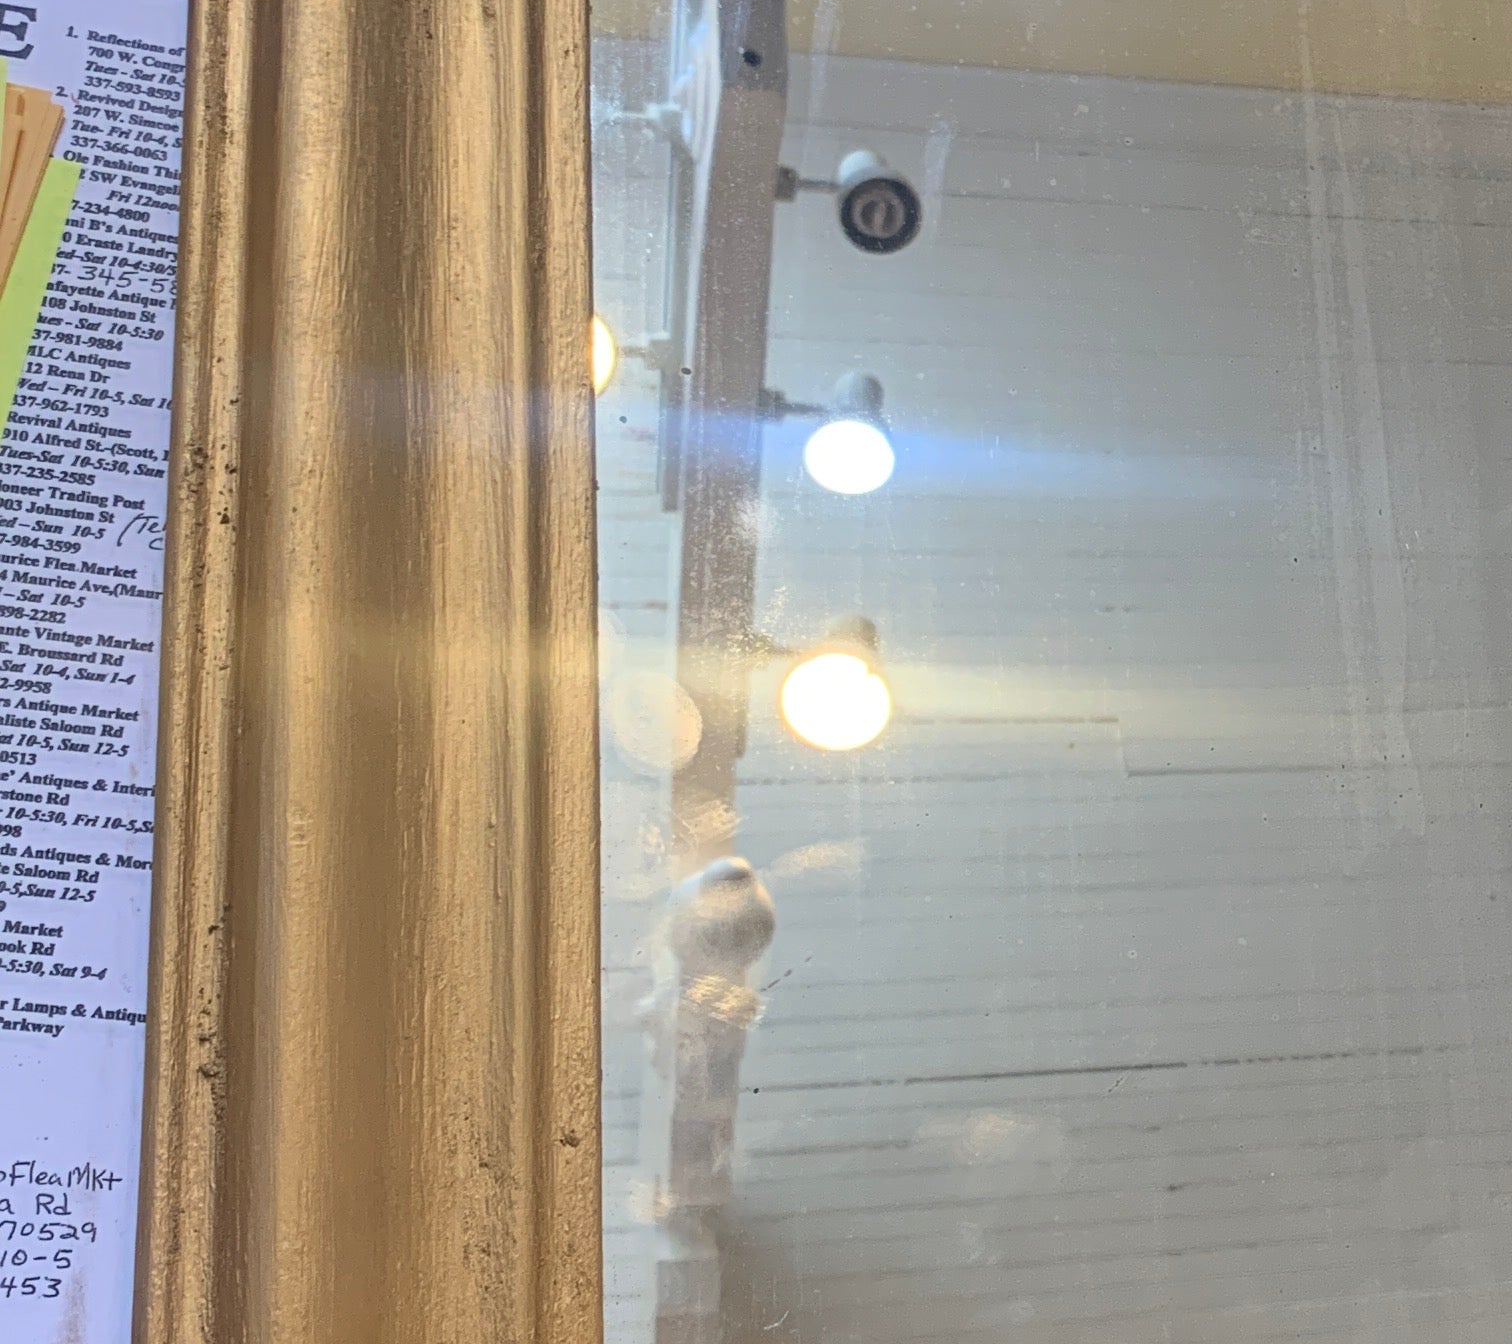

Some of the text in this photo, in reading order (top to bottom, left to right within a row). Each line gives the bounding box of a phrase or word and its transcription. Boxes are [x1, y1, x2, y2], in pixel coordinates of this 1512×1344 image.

[87, 30, 165, 54] Reflections
[169, 47, 186, 56] of
[88, 46, 113, 59] 700
[85, 61, 118, 75] Tues
[130, 69, 156, 82] Sat
[77, 90, 135, 109] Revived
[107, 126, 132, 139] Fri
[128, 115, 180, 132] Simcoe
[63, 150, 89, 164] Ole
[93, 155, 149, 174] Fashion
[89, 170, 117, 185] SW
[106, 190, 132, 203] Fri
[75, 233, 124, 252] Eraste
[107, 289, 167, 308] Antique
[69, 300, 136, 320] Johnston
[139, 311, 156, 323] St
[75, 318, 164, 341] Sat 10-5:30
[64, 351, 131, 370] Antiques
[90, 371, 111, 384] Dr
[62, 384, 87, 398] Fri
[128, 394, 155, 408] Sat
[7, 411, 132, 438] Revival Antiques
[31, 433, 82, 449] Alfred
[133, 464, 166, 478] Sun
[48, 486, 145, 510] Trading Post
[25, 502, 116, 523] Johnston St
[31, 520, 107, 539] Sun 10-5
[43, 557, 76, 571] Flea
[80, 561, 138, 579] Market
[11, 570, 77, 589] Maurice
[16, 589, 44, 603] Sat
[51, 593, 86, 608] 10-5
[34, 627, 93, 647] Vintage
[95, 634, 154, 652] Market
[18, 643, 97, 664] Broussard
[100, 654, 124, 667] Rd
[74, 668, 107, 683] Sun
[14, 697, 78, 716] Antique
[81, 704, 140, 722] Market
[40, 717, 96, 735] Saloom
[100, 724, 124, 738] Rd
[57, 738, 91, 753] Sun
[94, 742, 130, 757] 12-5
[18, 772, 89, 791] Antiques
[92, 779, 108, 792] &
[46, 792, 70, 806] Rd
[72, 814, 100, 827] Fri
[20, 845, 91, 864] Antiques
[95, 853, 111, 866] &
[13, 863, 100, 884] Saloom Rd
[59, 887, 96, 903] 12-5
[2, 920, 64, 938] Market
[30, 942, 56, 956] Rd
[50, 963, 78, 978] Sat
[12, 998, 68, 1017] Lamps
[71, 1004, 87, 1017] &
[35, 1192, 72, 1216] Rd
